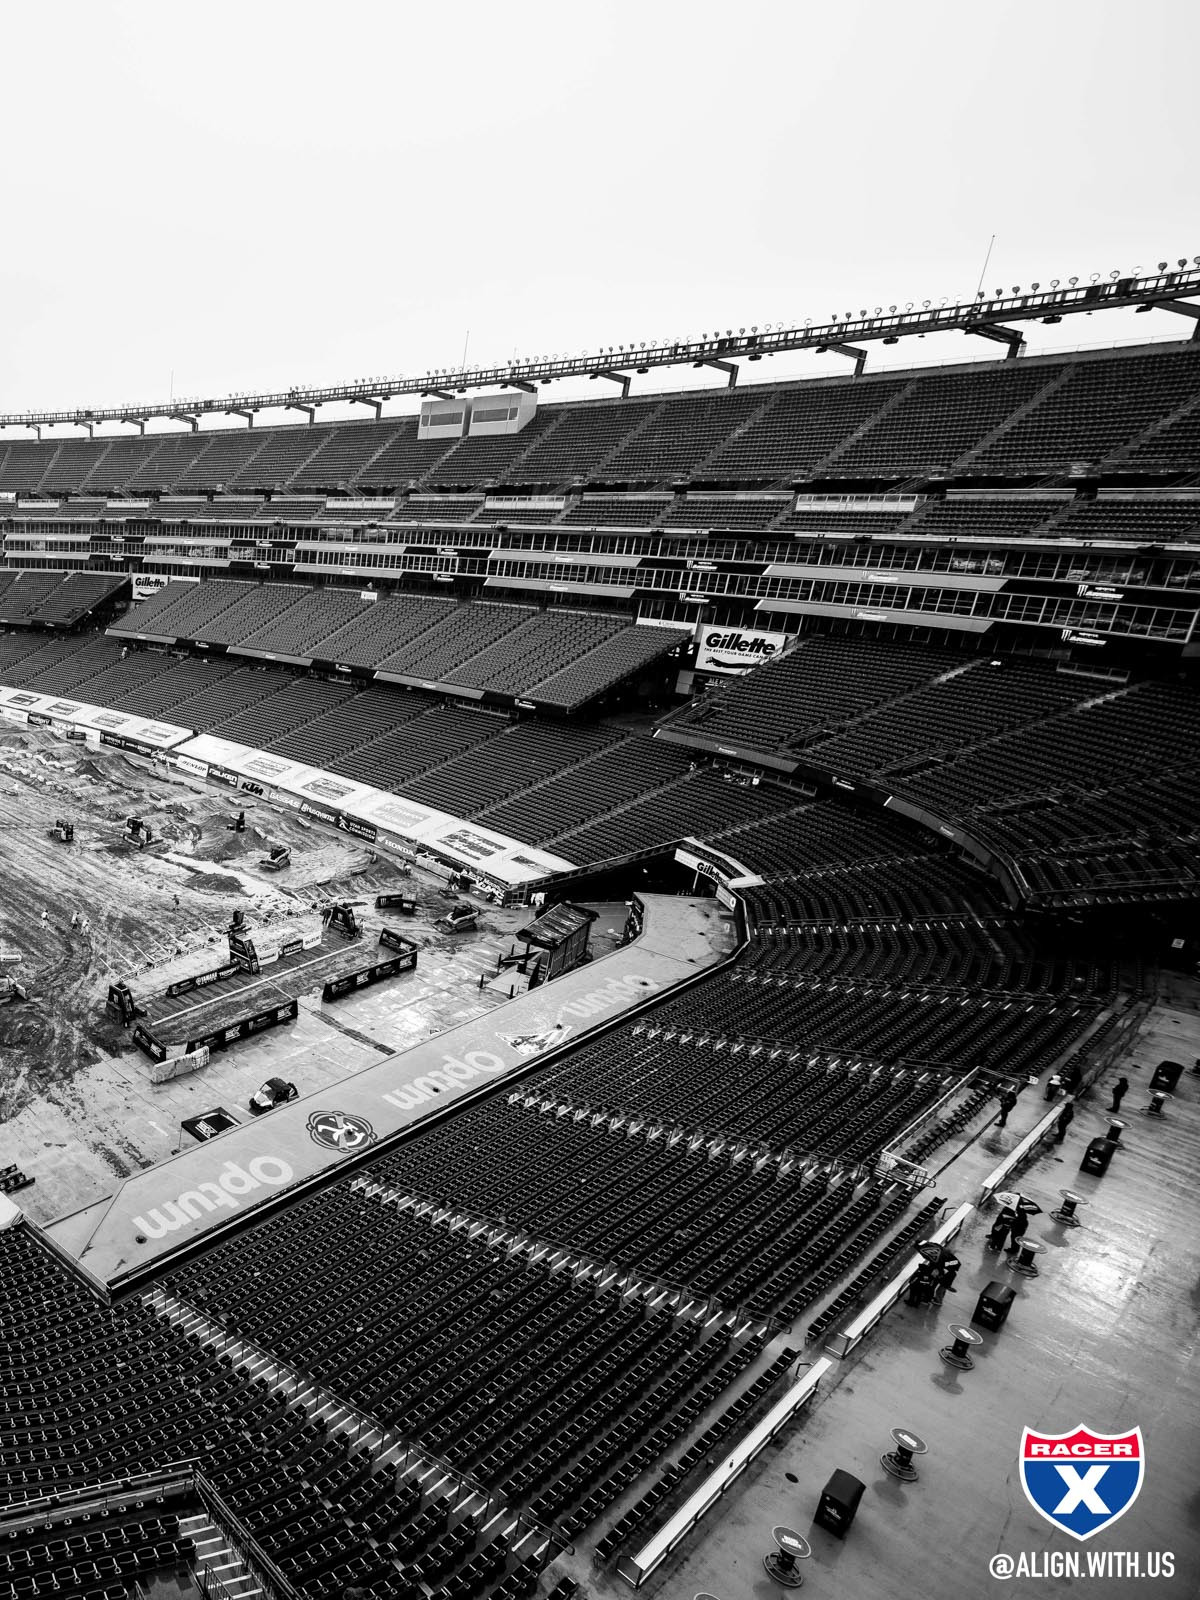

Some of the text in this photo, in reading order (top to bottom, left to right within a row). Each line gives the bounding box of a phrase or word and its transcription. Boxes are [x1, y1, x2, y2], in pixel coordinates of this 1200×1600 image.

[135, 576, 165, 588] Gillette
[705, 632, 776, 656] Gillette
[182, 760, 207, 772] DUNLOP
[241, 781, 264, 796] KTM
[385, 840, 414, 857] HONDA
